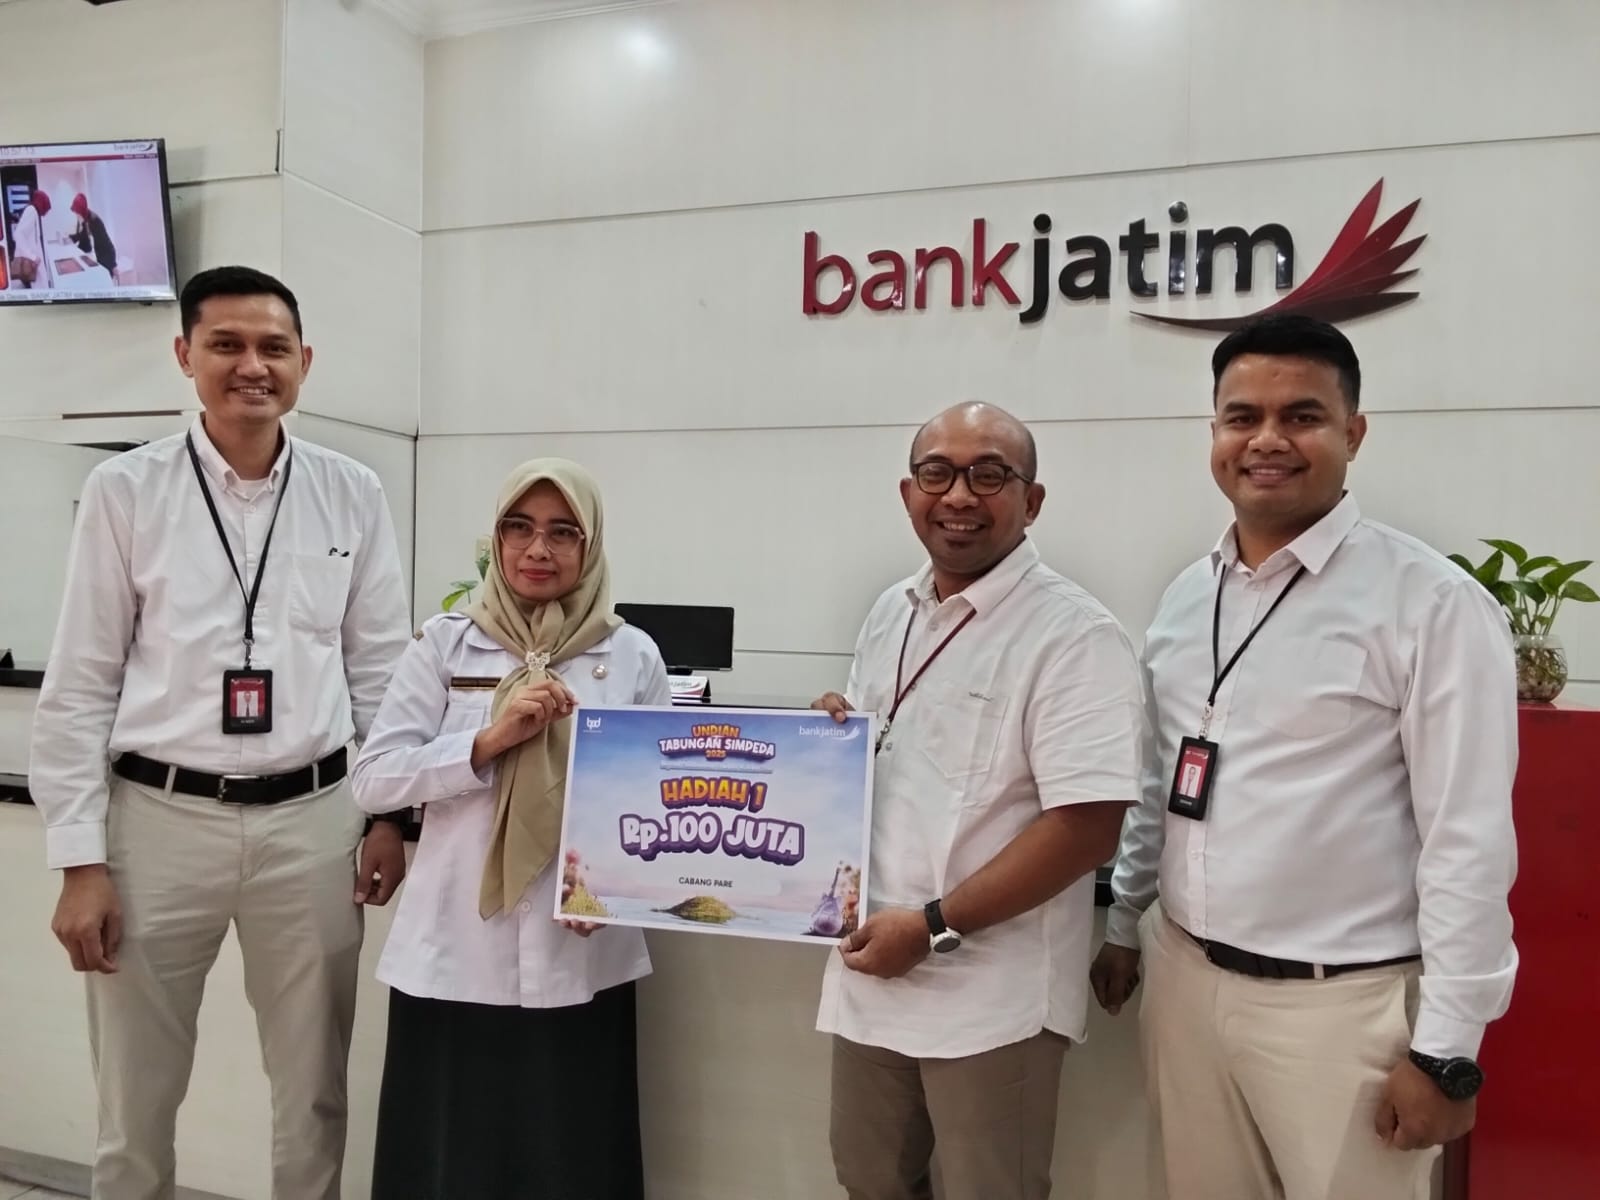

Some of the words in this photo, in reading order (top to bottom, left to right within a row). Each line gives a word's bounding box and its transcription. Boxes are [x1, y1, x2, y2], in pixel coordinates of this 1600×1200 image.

[803, 201, 1294, 324] bankjatim
[692, 724, 740, 737] UNDIAN
[799, 726, 846, 737] bankjatim
[659, 738, 721, 752] TABUNGAN
[724, 738, 774, 757] SIMPEDA
[705, 749, 727, 759] 2025
[662, 777, 750, 805] HADIAH
[752, 783, 766, 808] 1
[621, 814, 720, 852] Rp.100
[725, 817, 801, 857] JUTA
[678, 876, 713, 887] CABANG
[713, 879, 733, 888] PARE
